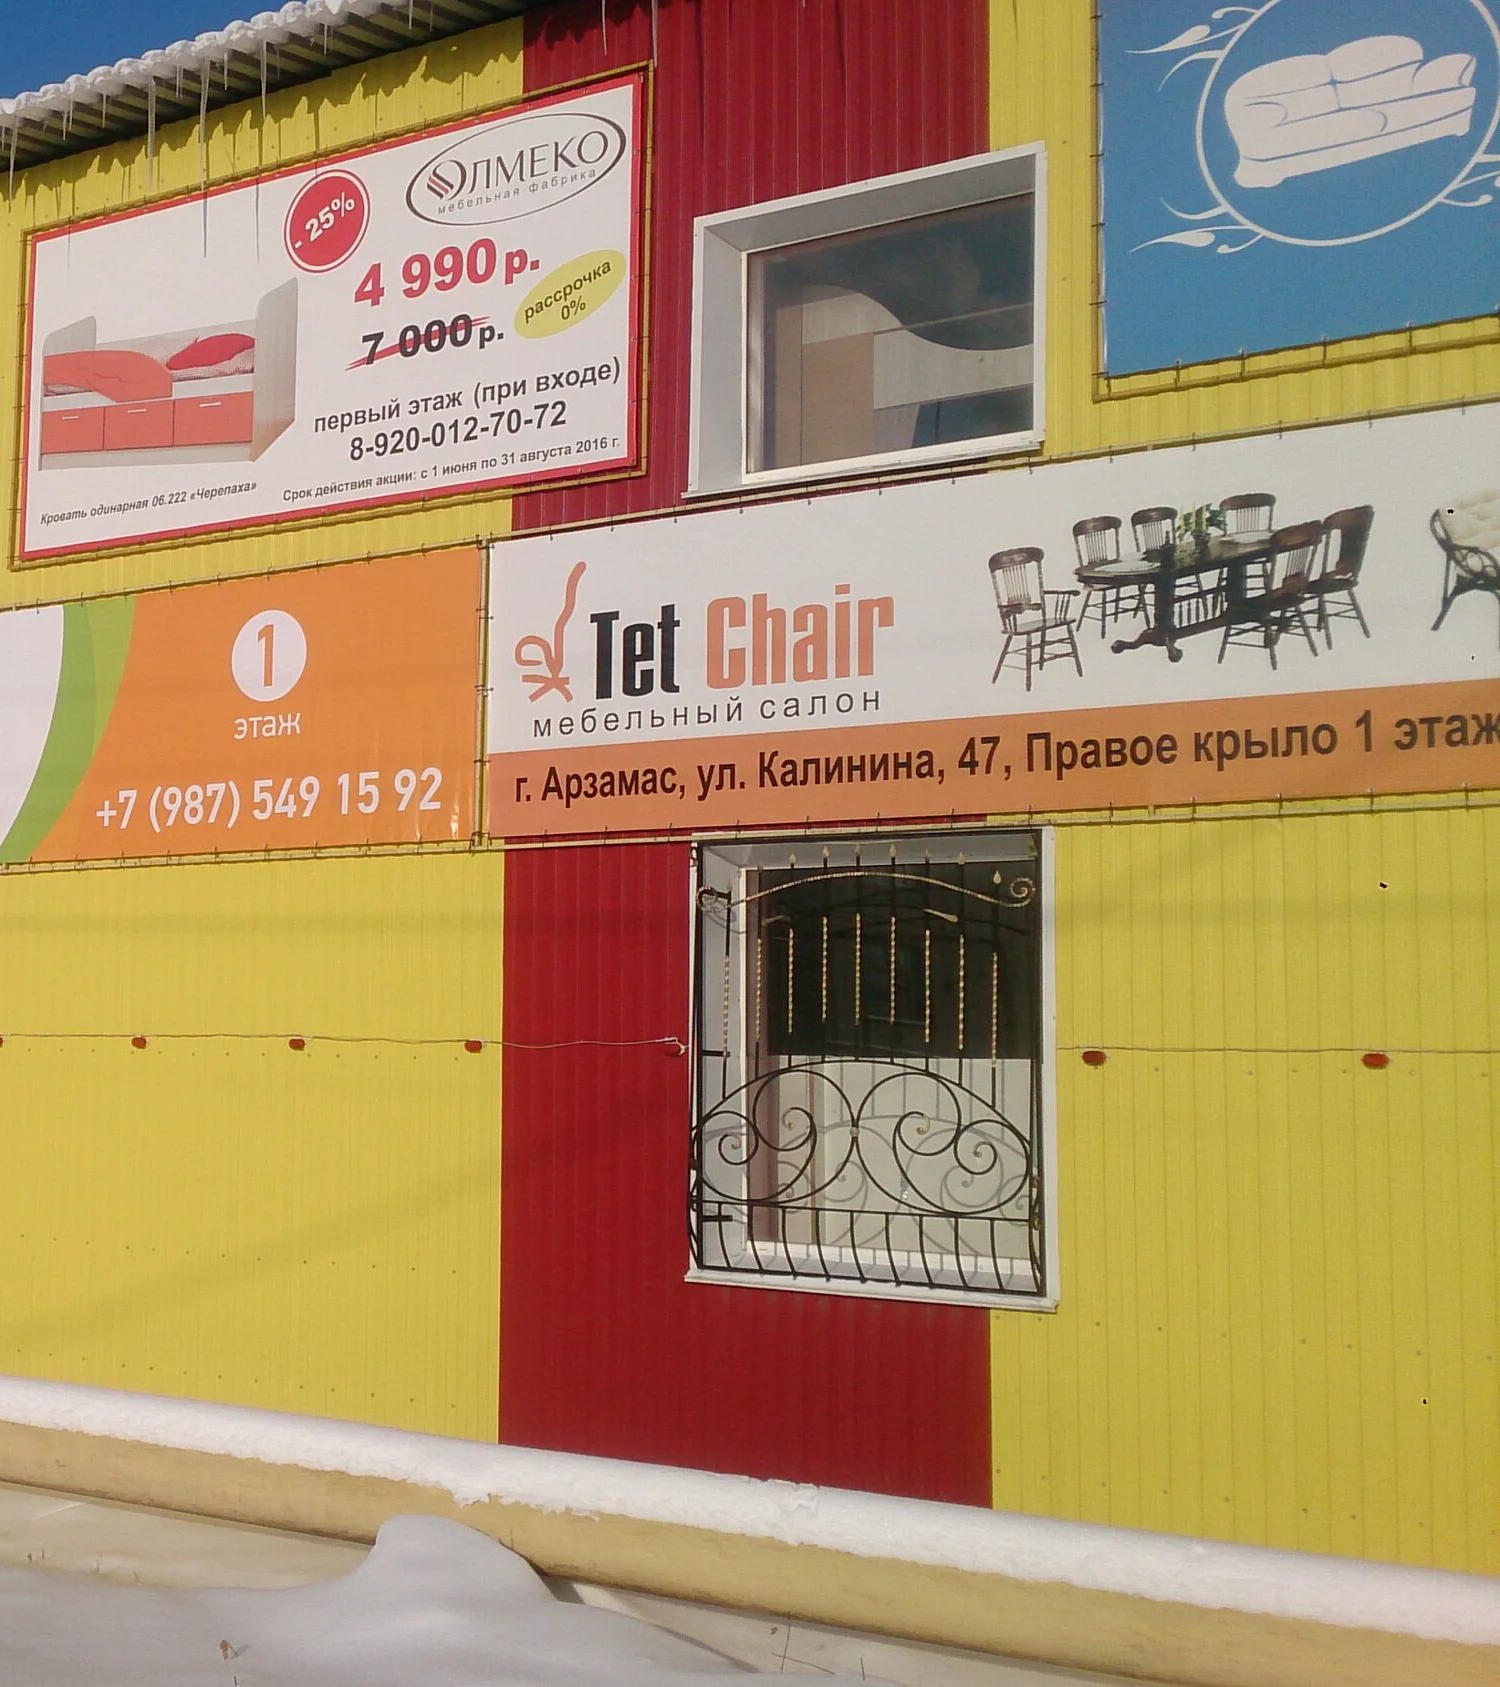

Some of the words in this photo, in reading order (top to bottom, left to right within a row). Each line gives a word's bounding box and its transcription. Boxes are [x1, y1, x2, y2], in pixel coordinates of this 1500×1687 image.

[426, 130, 609, 201] ОЛМЕКО
[437, 187, 520, 215] мебельная
[528, 169, 596, 195] фабрика
[354, 262, 385, 307] 4
[402, 238, 497, 299] 990
[504, 248, 541, 286] р.
[524, 259, 612, 324] рассрочка
[361, 331, 385, 366] 7
[398, 313, 473, 358] 000
[478, 323, 504, 350] р.
[560, 299, 587, 322] 0%
[314, 398, 400, 433] первый
[407, 389, 463, 416] этаж
[473, 380, 527, 409] (при
[535, 356, 621, 393] входе)
[349, 400, 567, 462] 8-920-012-70-72
[283, 488, 314, 503] Срок
[314, 477, 373, 499] действия
[375, 470, 417, 489] акции:
[420, 469, 429, 480] с
[431, 464, 438, 478] 1
[442, 461, 477, 476] июня
[481, 456, 498, 470] по
[501, 452, 516, 466] 31
[519, 444, 572, 466] августа
[575, 438, 608, 455] 2016
[611, 436, 621, 449] г.
[40, 509, 88, 526] Кровать
[90, 498, 150, 517] одинарная
[151, 491, 187, 507] 06.222
[190, 481, 257, 501] «Черепаха»
[256, 623, 275, 689] 1
[589, 603, 681, 700] Tet
[706, 584, 895, 690] Chair
[233, 712, 302, 740] этаж
[533, 696, 744, 738] мебельный
[759, 690, 881, 720] салон
[515, 776, 532, 803] г.
[541, 766, 687, 808] Арзамас,
[696, 763, 747, 801] ул.
[758, 748, 945, 788] Калинина,
[957, 735, 1011, 781] 47,
[1026, 731, 1178, 781] Правое
[1194, 721, 1338, 772] крыло
[1354, 709, 1374, 753] 1
[1393, 712, 1500, 751] этаж
[96, 789, 138, 830] +7
[148, 780, 240, 833] (987)
[253, 775, 320, 821] 549
[337, 771, 380, 815] 15
[394, 766, 442, 812] 92
